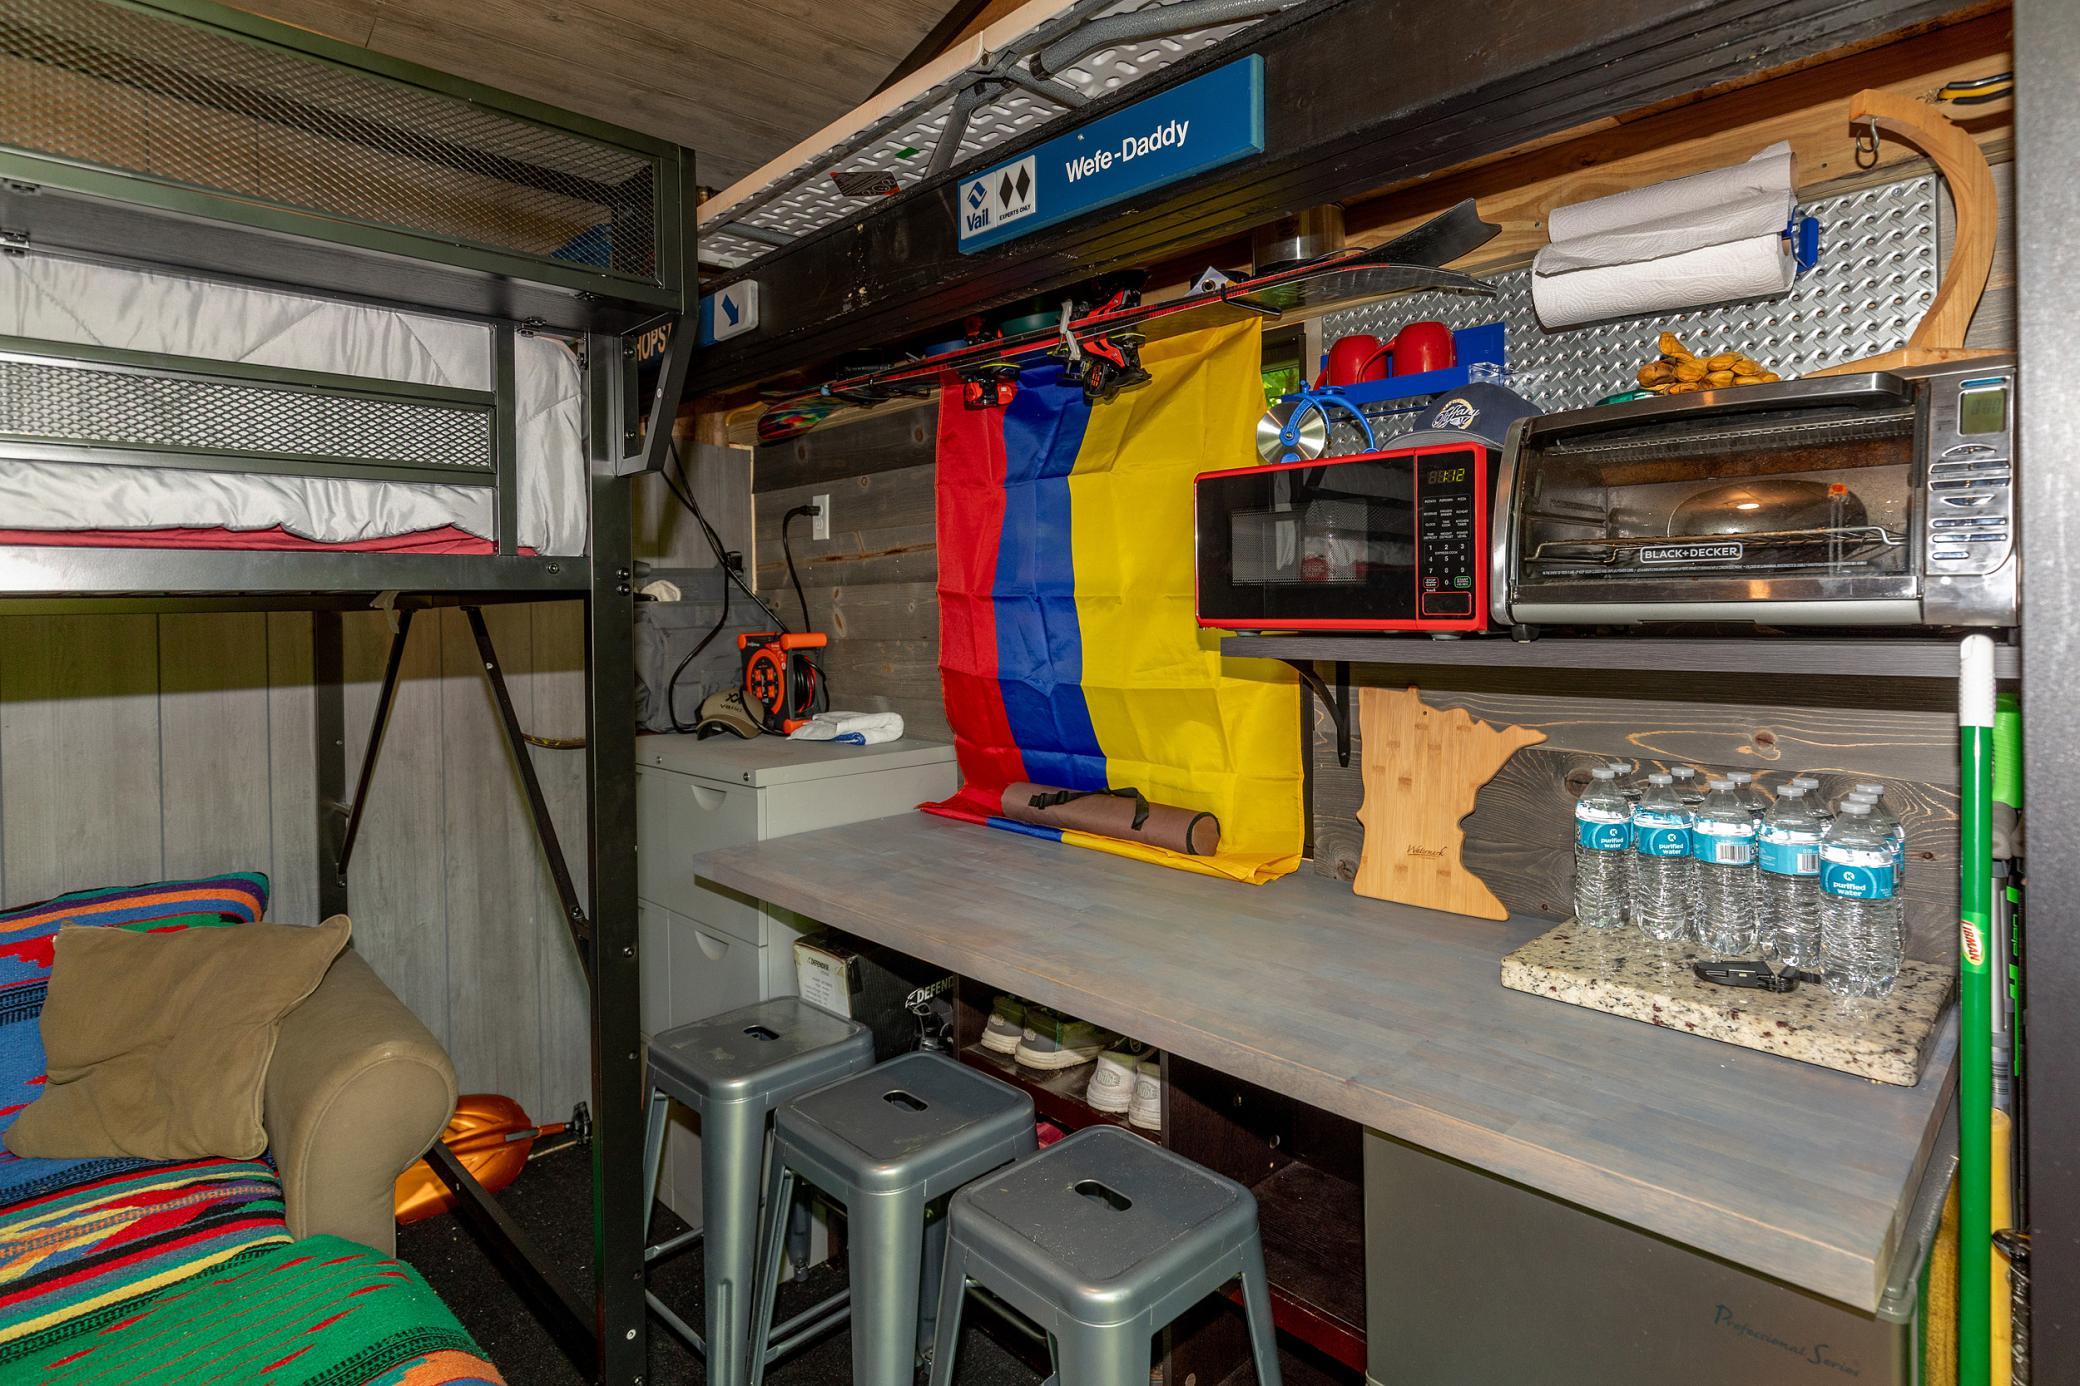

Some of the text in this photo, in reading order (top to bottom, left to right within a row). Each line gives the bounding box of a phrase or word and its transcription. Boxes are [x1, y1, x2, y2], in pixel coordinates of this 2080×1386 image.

[1065, 120, 1189, 183] Wefe-Daddy
[999, 203, 1031, 221] EXPERTS ONLY
[966, 210, 989, 231] Vail
[1645, 547, 1738, 559] BLACK+DECKER
[1833, 881, 1866, 892] purified
[1837, 889, 1863, 897] water
